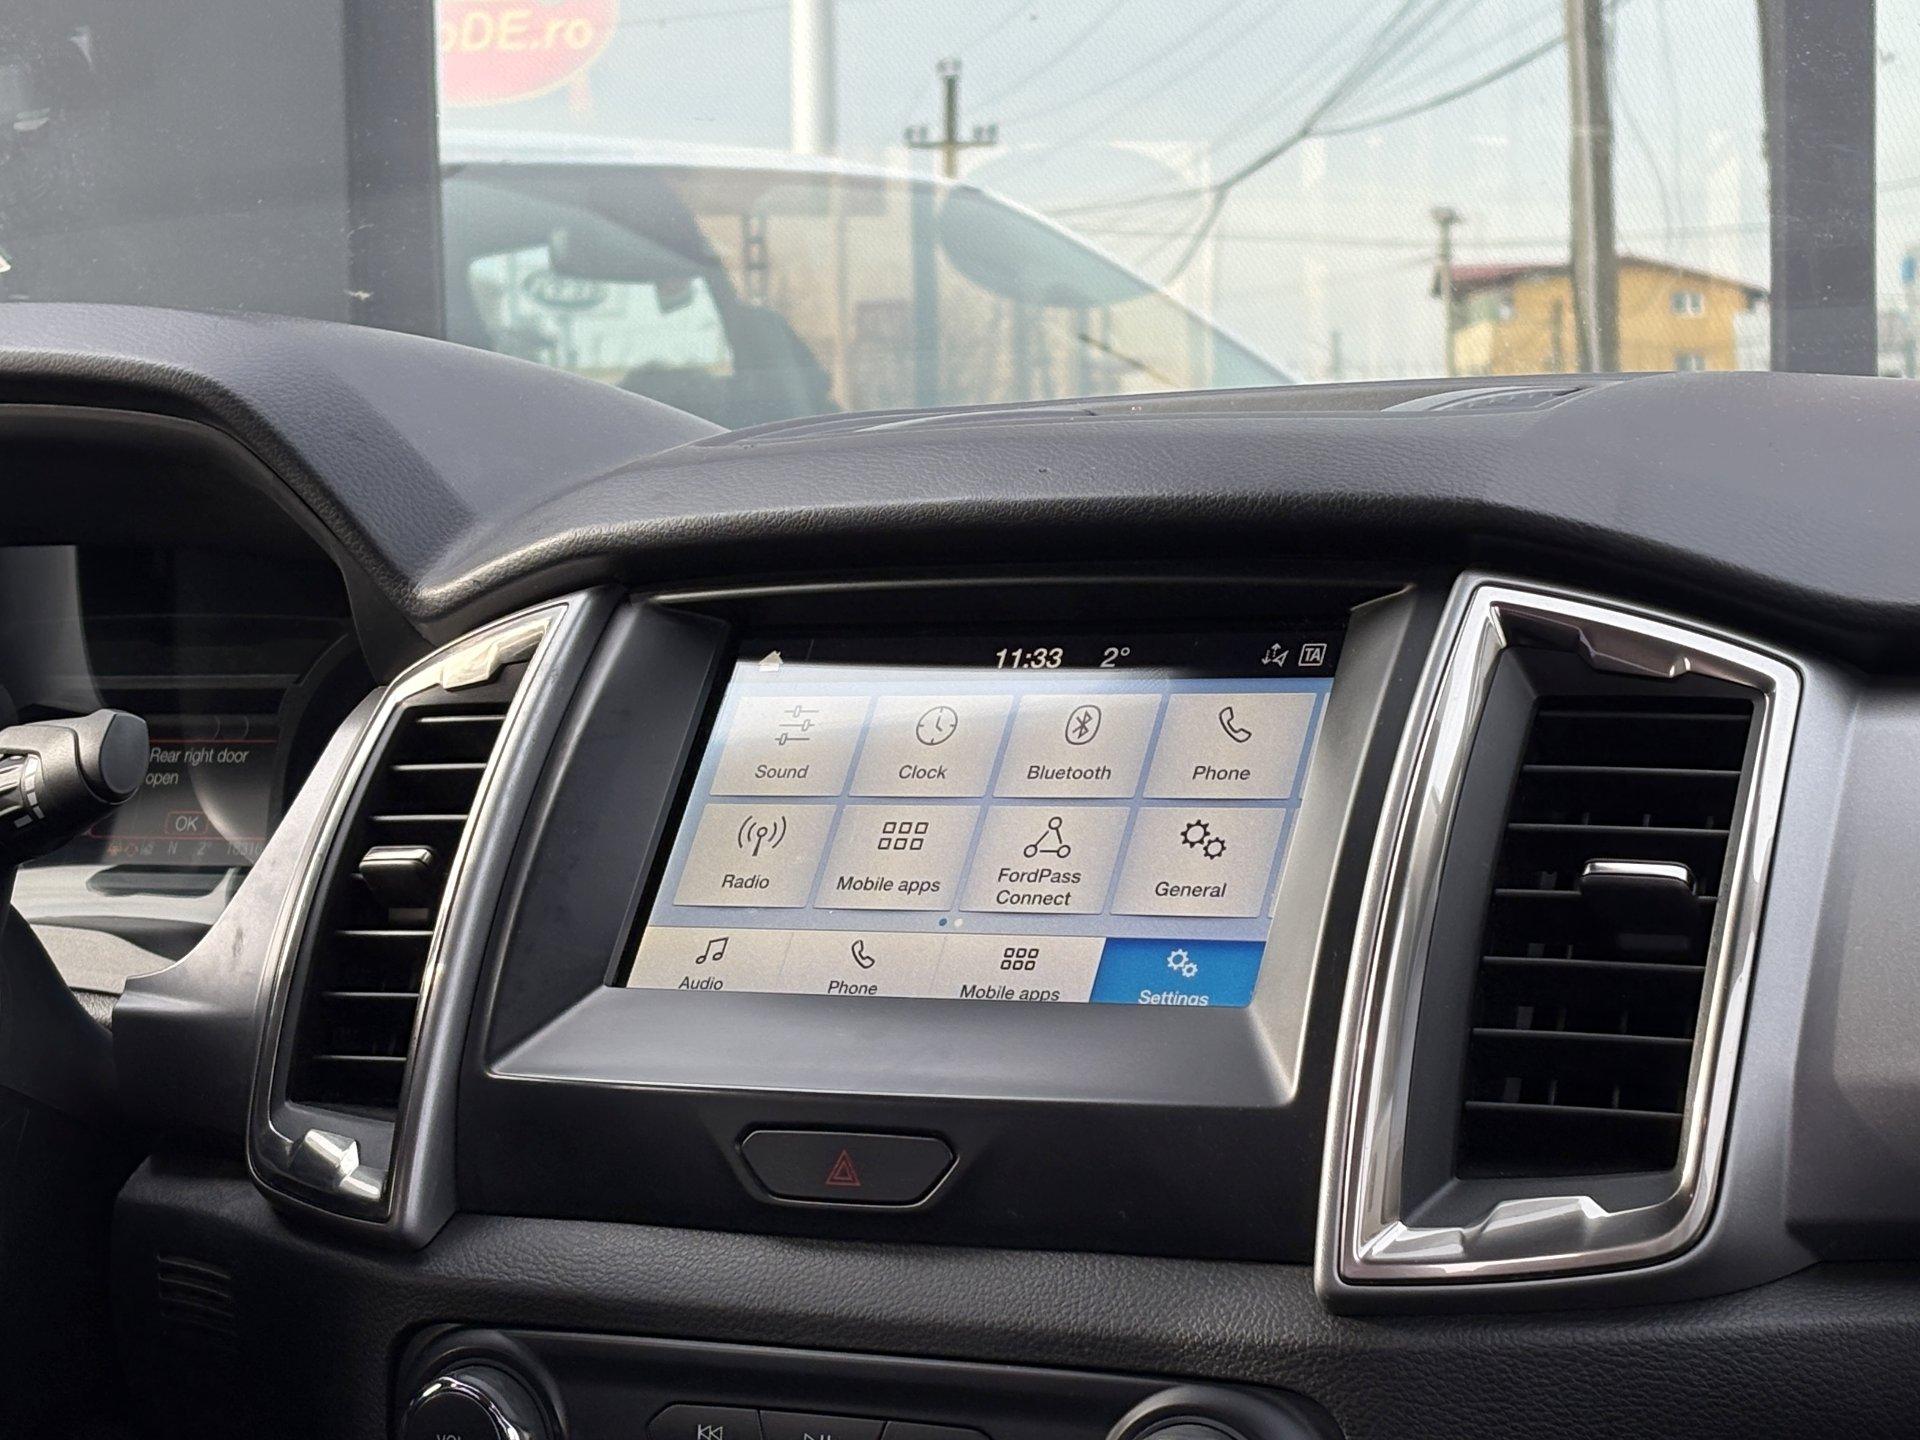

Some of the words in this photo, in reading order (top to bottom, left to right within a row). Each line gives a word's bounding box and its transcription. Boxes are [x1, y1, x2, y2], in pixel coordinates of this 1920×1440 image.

[995, 647, 1064, 669] 11:33
[1099, 646, 1131, 668] 2°
[1304, 648, 1322, 662] TA
[150, 747, 181, 764] Rear
[184, 746, 214, 767] right
[216, 747, 249, 764] door
[754, 764, 810, 779] Sound
[898, 765, 949, 780] Clock
[1026, 765, 1112, 780] Bluetooth
[1191, 765, 1251, 781] Phone
[145, 772, 180, 788] open
[174, 815, 200, 832] OK
[720, 874, 770, 890] Radio
[997, 867, 1082, 884] FordPass
[835, 876, 894, 892] Mobile
[897, 878, 941, 895] apps
[1154, 881, 1228, 898] General
[995, 889, 1072, 906] Connect
[677, 976, 724, 991] Audio
[826, 980, 878, 996] Phone
[959, 984, 1017, 1000] Mobile
[1018, 988, 1061, 1002] apps
[1137, 989, 1210, 1007] Settings
